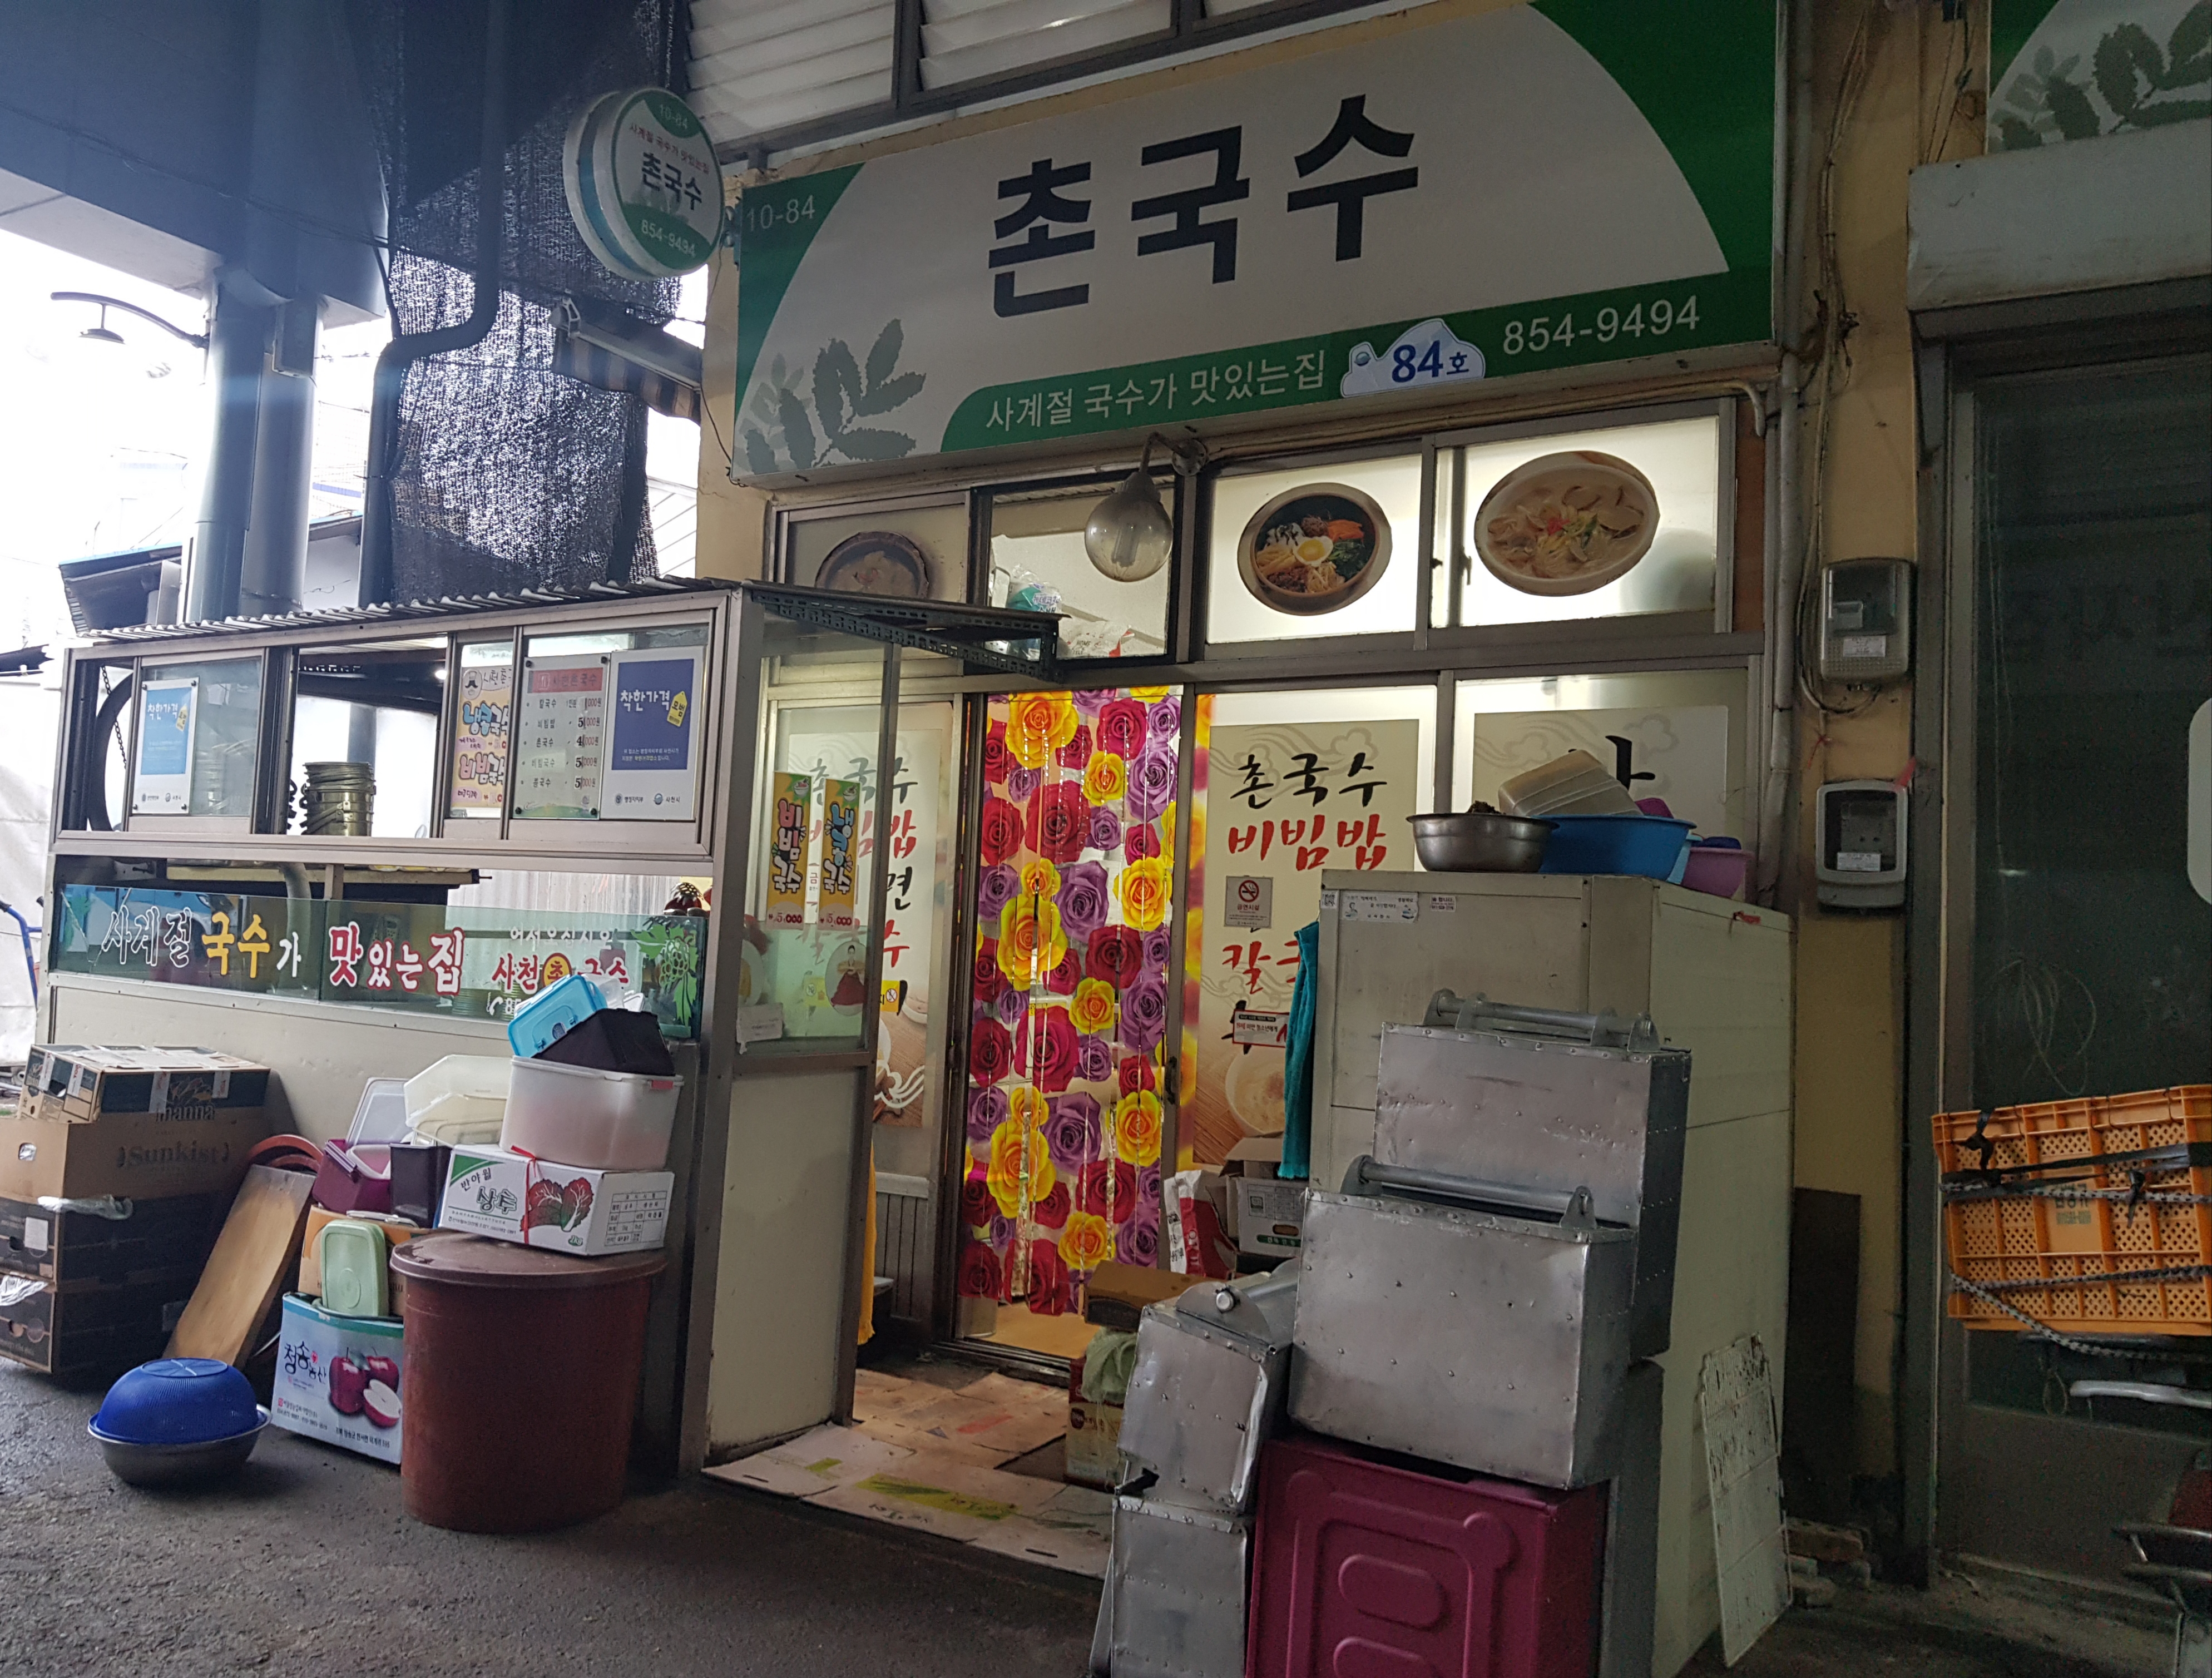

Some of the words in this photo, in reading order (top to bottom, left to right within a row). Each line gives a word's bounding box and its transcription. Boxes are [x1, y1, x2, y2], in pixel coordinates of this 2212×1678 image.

[642, 152, 702, 211] 촌국수
[988, 93, 1419, 318] 촌국수
[641, 219, 696, 258] 854-9494
[746, 194, 816, 232] 10-84
[1502, 295, 1700, 356] 854-9494
[1390, 338, 1469, 384] 84호
[986, 388, 1073, 433] 사계절
[1084, 375, 1178, 422] 국수가
[1190, 349, 1325, 407] 맛있는집
[147, 702, 179, 720] 착한가격
[620, 689, 670, 712] 착한가격
[1230, 752, 1387, 809] 촌국수
[1228, 814, 1387, 871] 비빔밥
[101, 905, 194, 968] 사계절
[460, 1167, 492, 1192] 반야월
[477, 1185, 518, 1215] 상추
